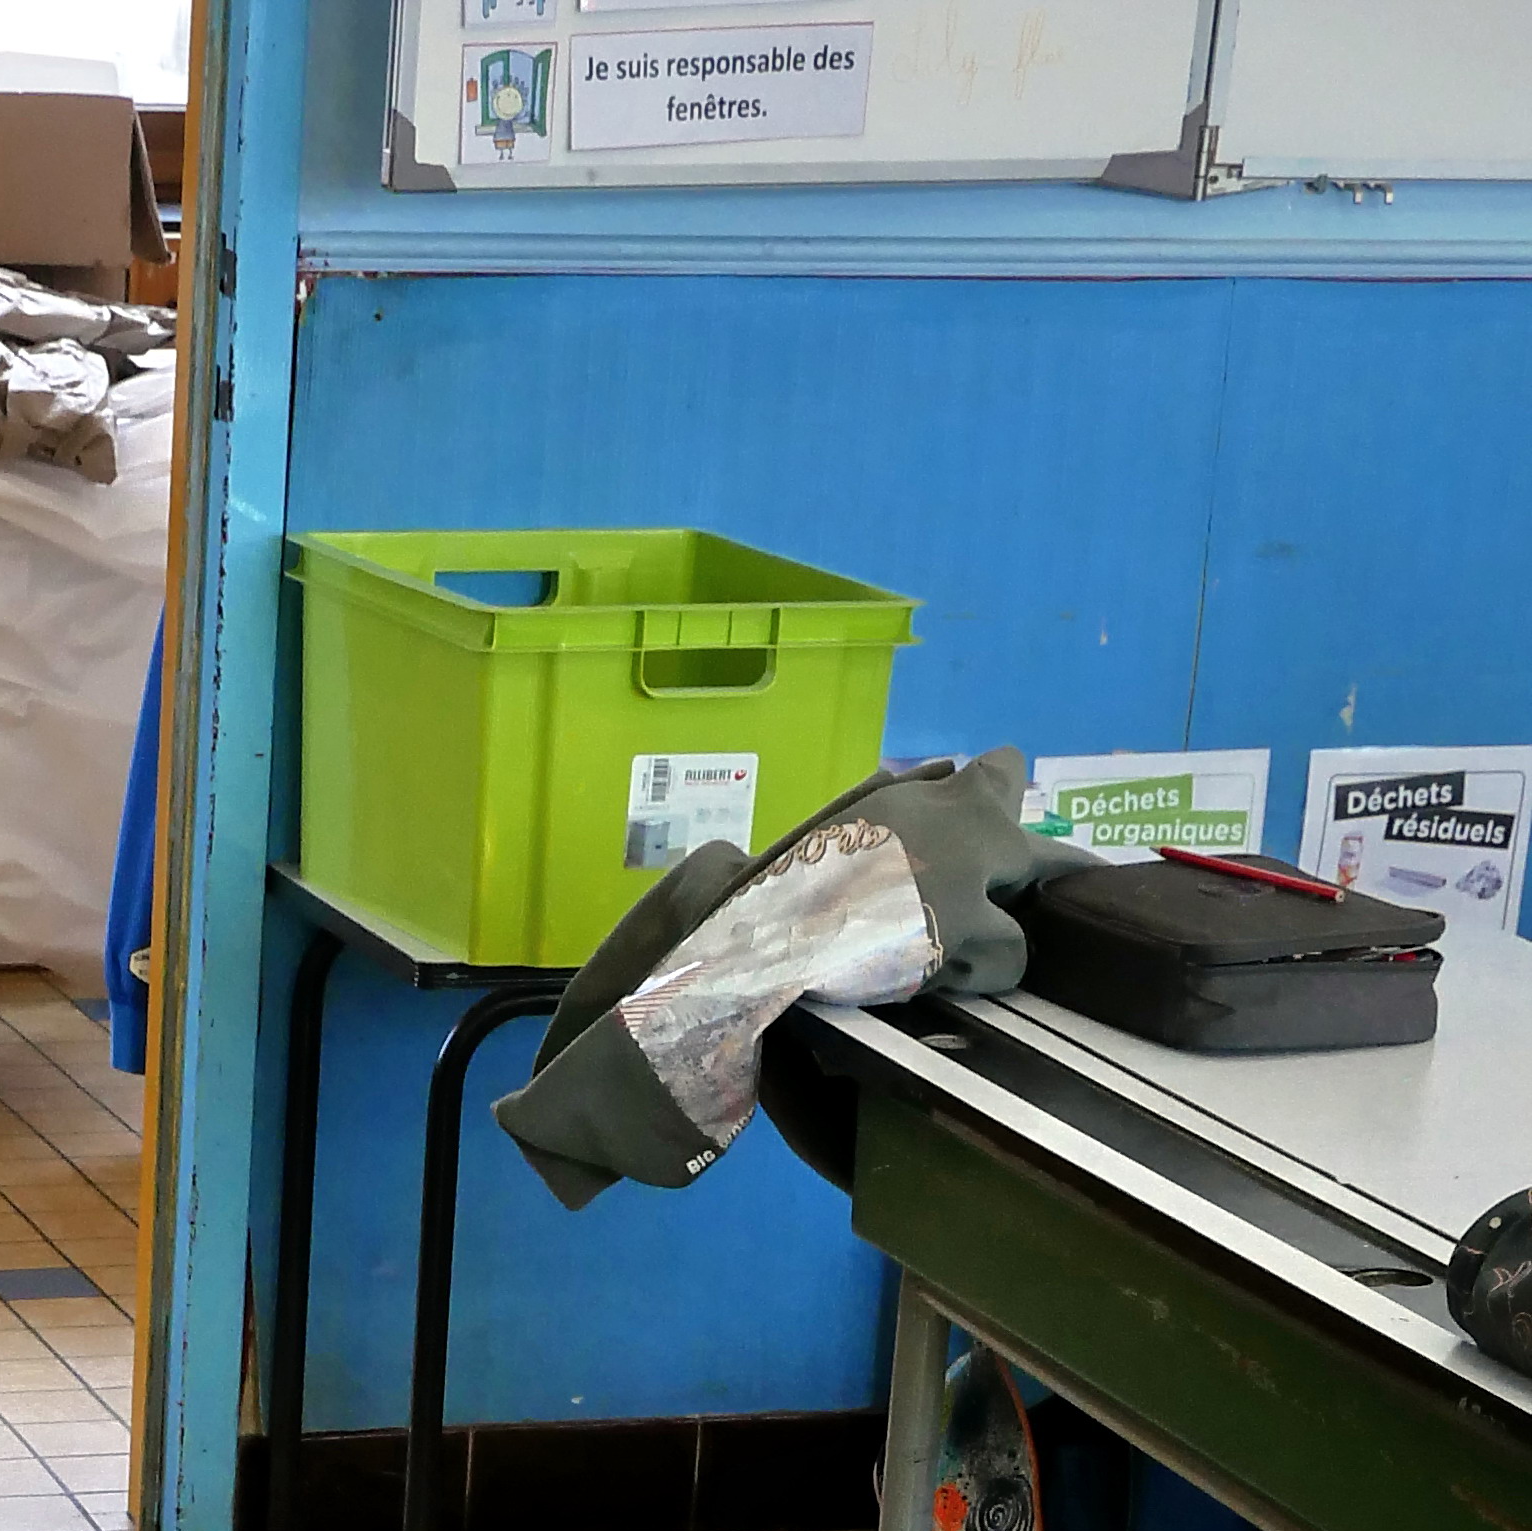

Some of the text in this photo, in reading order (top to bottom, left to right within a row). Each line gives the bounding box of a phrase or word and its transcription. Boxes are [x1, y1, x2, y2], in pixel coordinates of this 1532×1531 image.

[584, 45, 855, 82] Je suis responsable des
[665, 92, 768, 123] fenêtres.
[1070, 786, 1181, 820] Déchets
[1346, 782, 1453, 815] Déchets
[1094, 819, 1244, 846] organiques
[1391, 813, 1506, 844] résiduels
